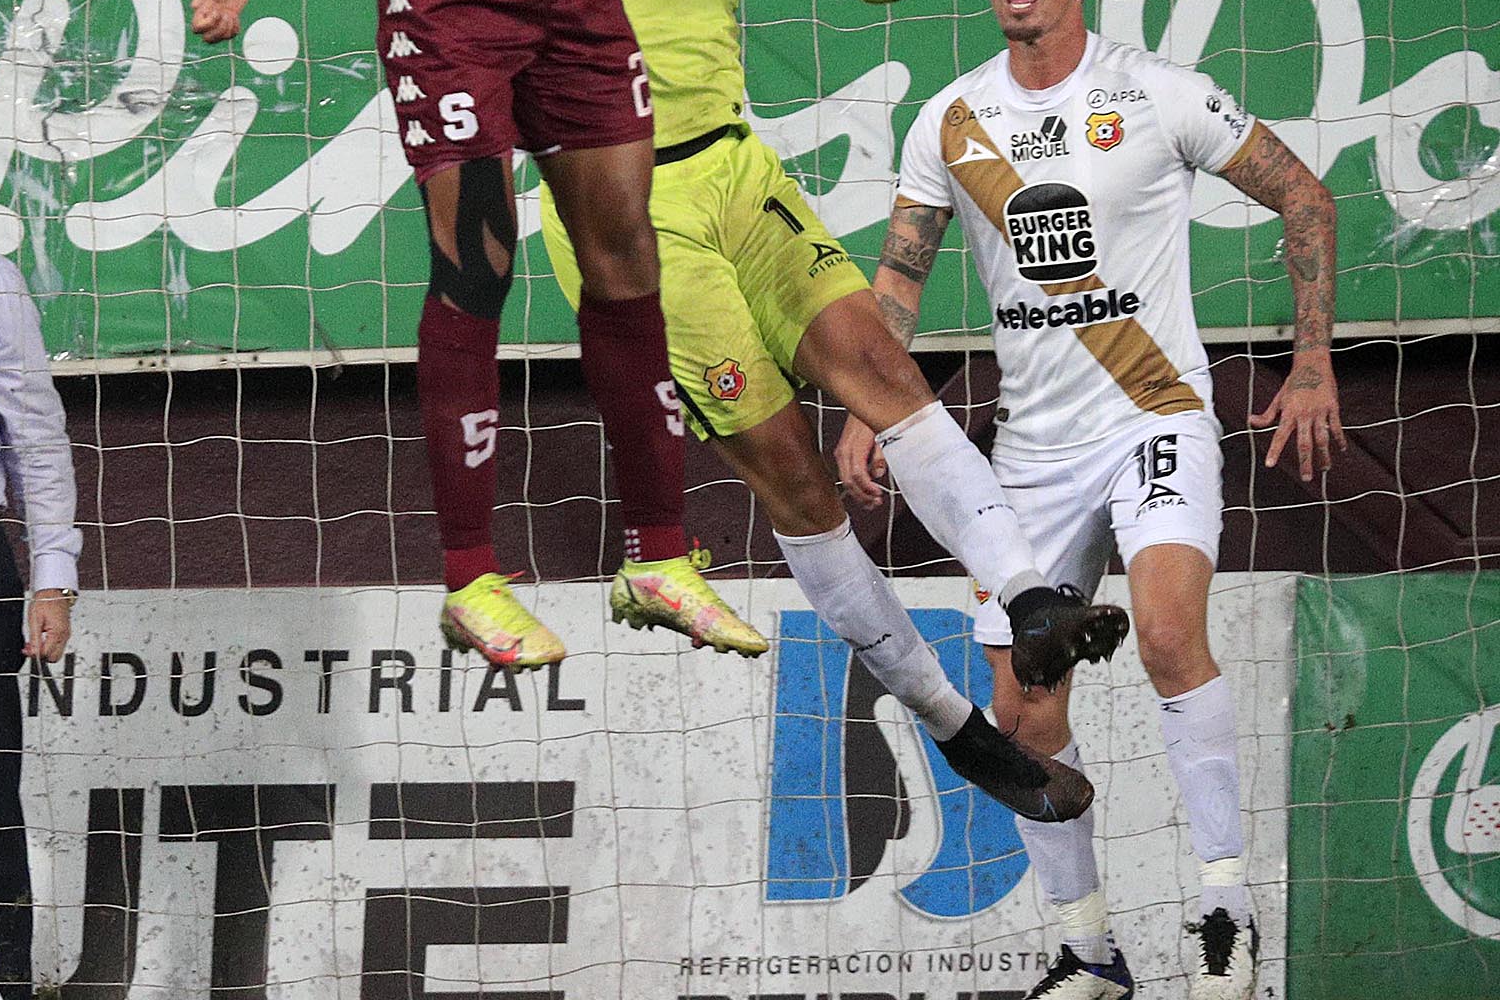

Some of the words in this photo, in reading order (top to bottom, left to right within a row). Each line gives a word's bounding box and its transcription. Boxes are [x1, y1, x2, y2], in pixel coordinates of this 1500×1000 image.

[1109, 89, 1149, 104] APSA
[438, 91, 479, 141] S
[967, 106, 1002, 121] APSA
[1011, 132, 1045, 149] SAN
[1012, 142, 1070, 163] MIGUEL
[763, 196, 805, 236] 1
[1009, 210, 1091, 237] BURGER
[1014, 232, 1096, 265] KING
[997, 288, 1140, 330] telecable
[1132, 433, 1178, 489] 16
[27, 647, 587, 718] NDUSTRIAL
[678, 954, 912, 976] REFRIGERACION
[928, 952, 1050, 973] INDUSTR
